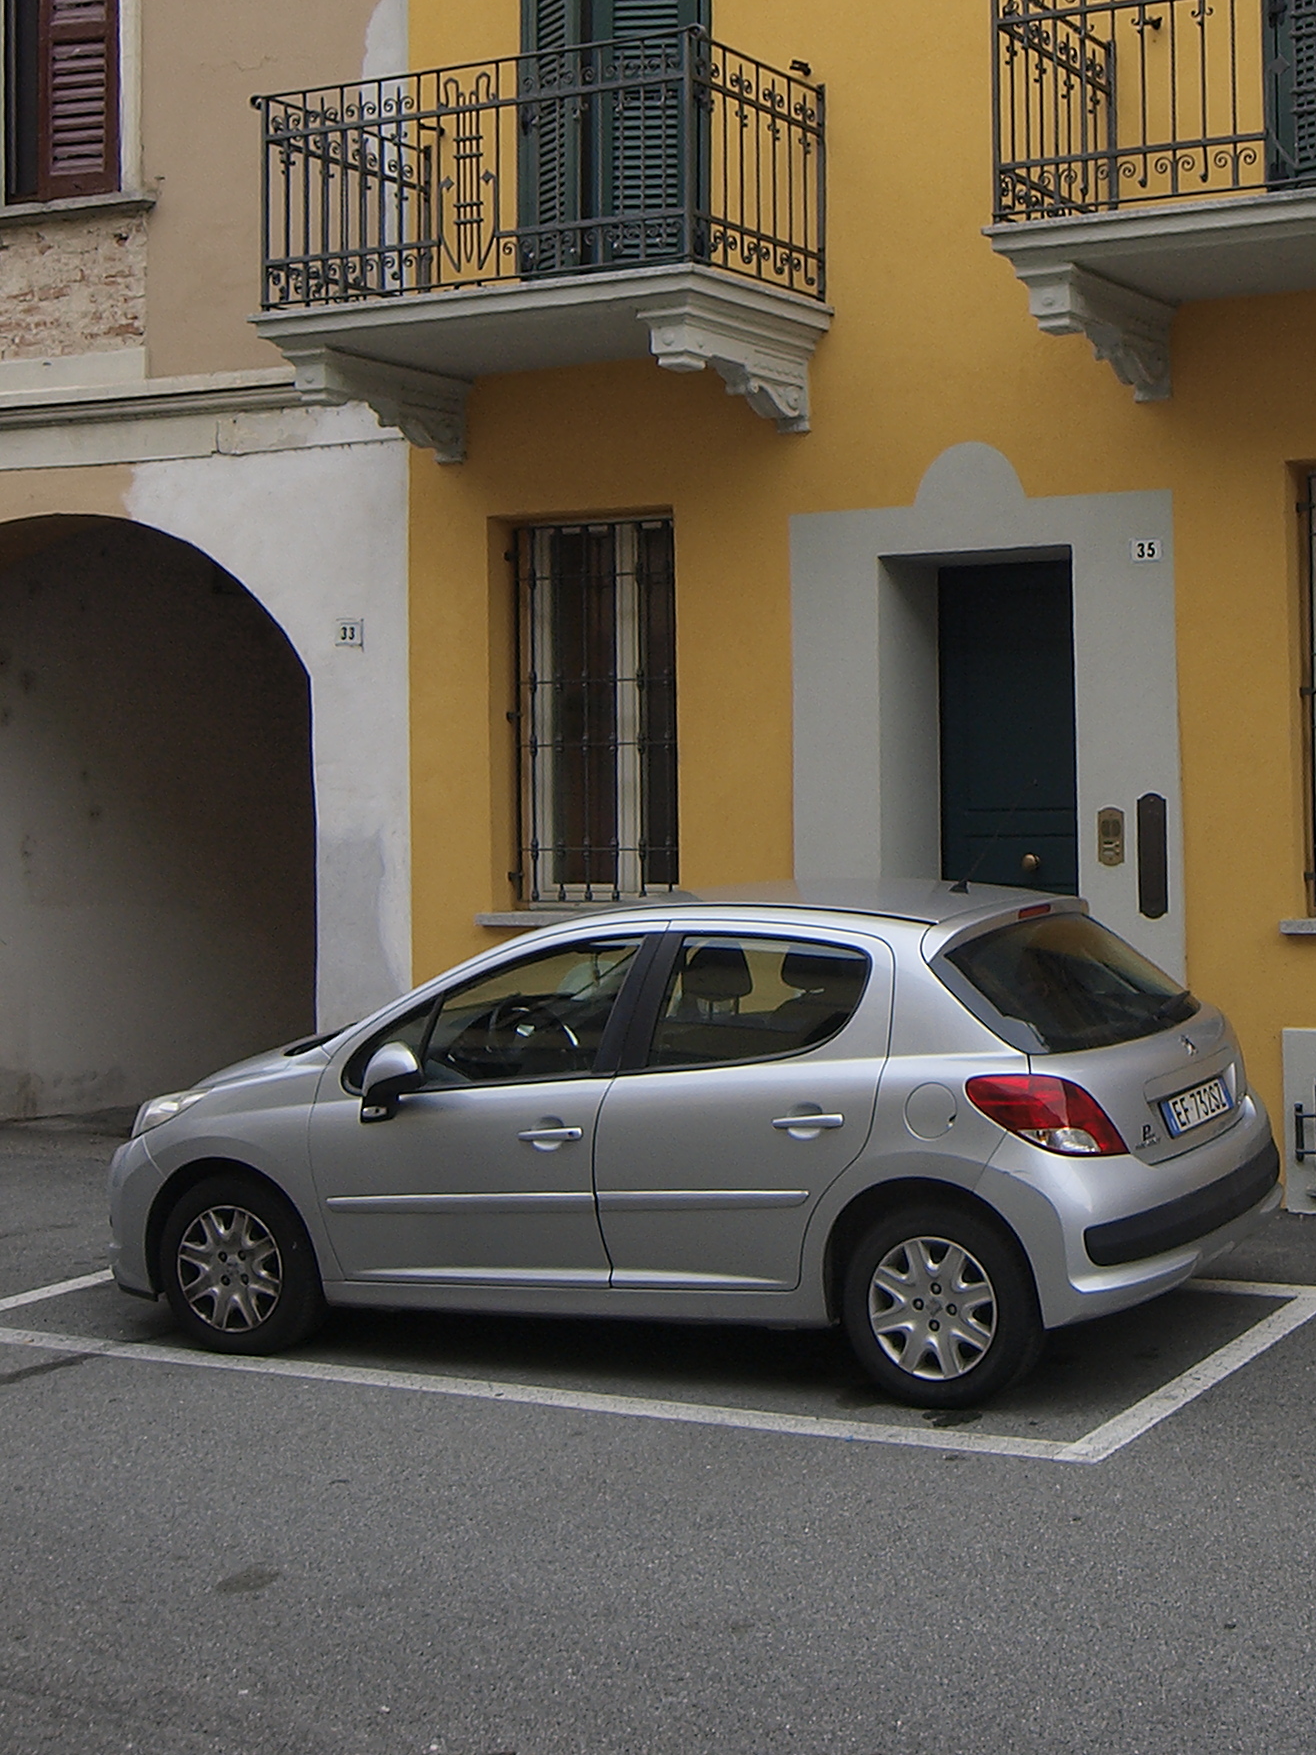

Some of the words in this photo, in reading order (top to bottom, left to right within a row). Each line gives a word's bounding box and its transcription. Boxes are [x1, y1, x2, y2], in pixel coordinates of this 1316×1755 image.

[1136, 541, 1156, 559] 35
[340, 625, 356, 641] 33
[1171, 1097, 1191, 1128] EF
